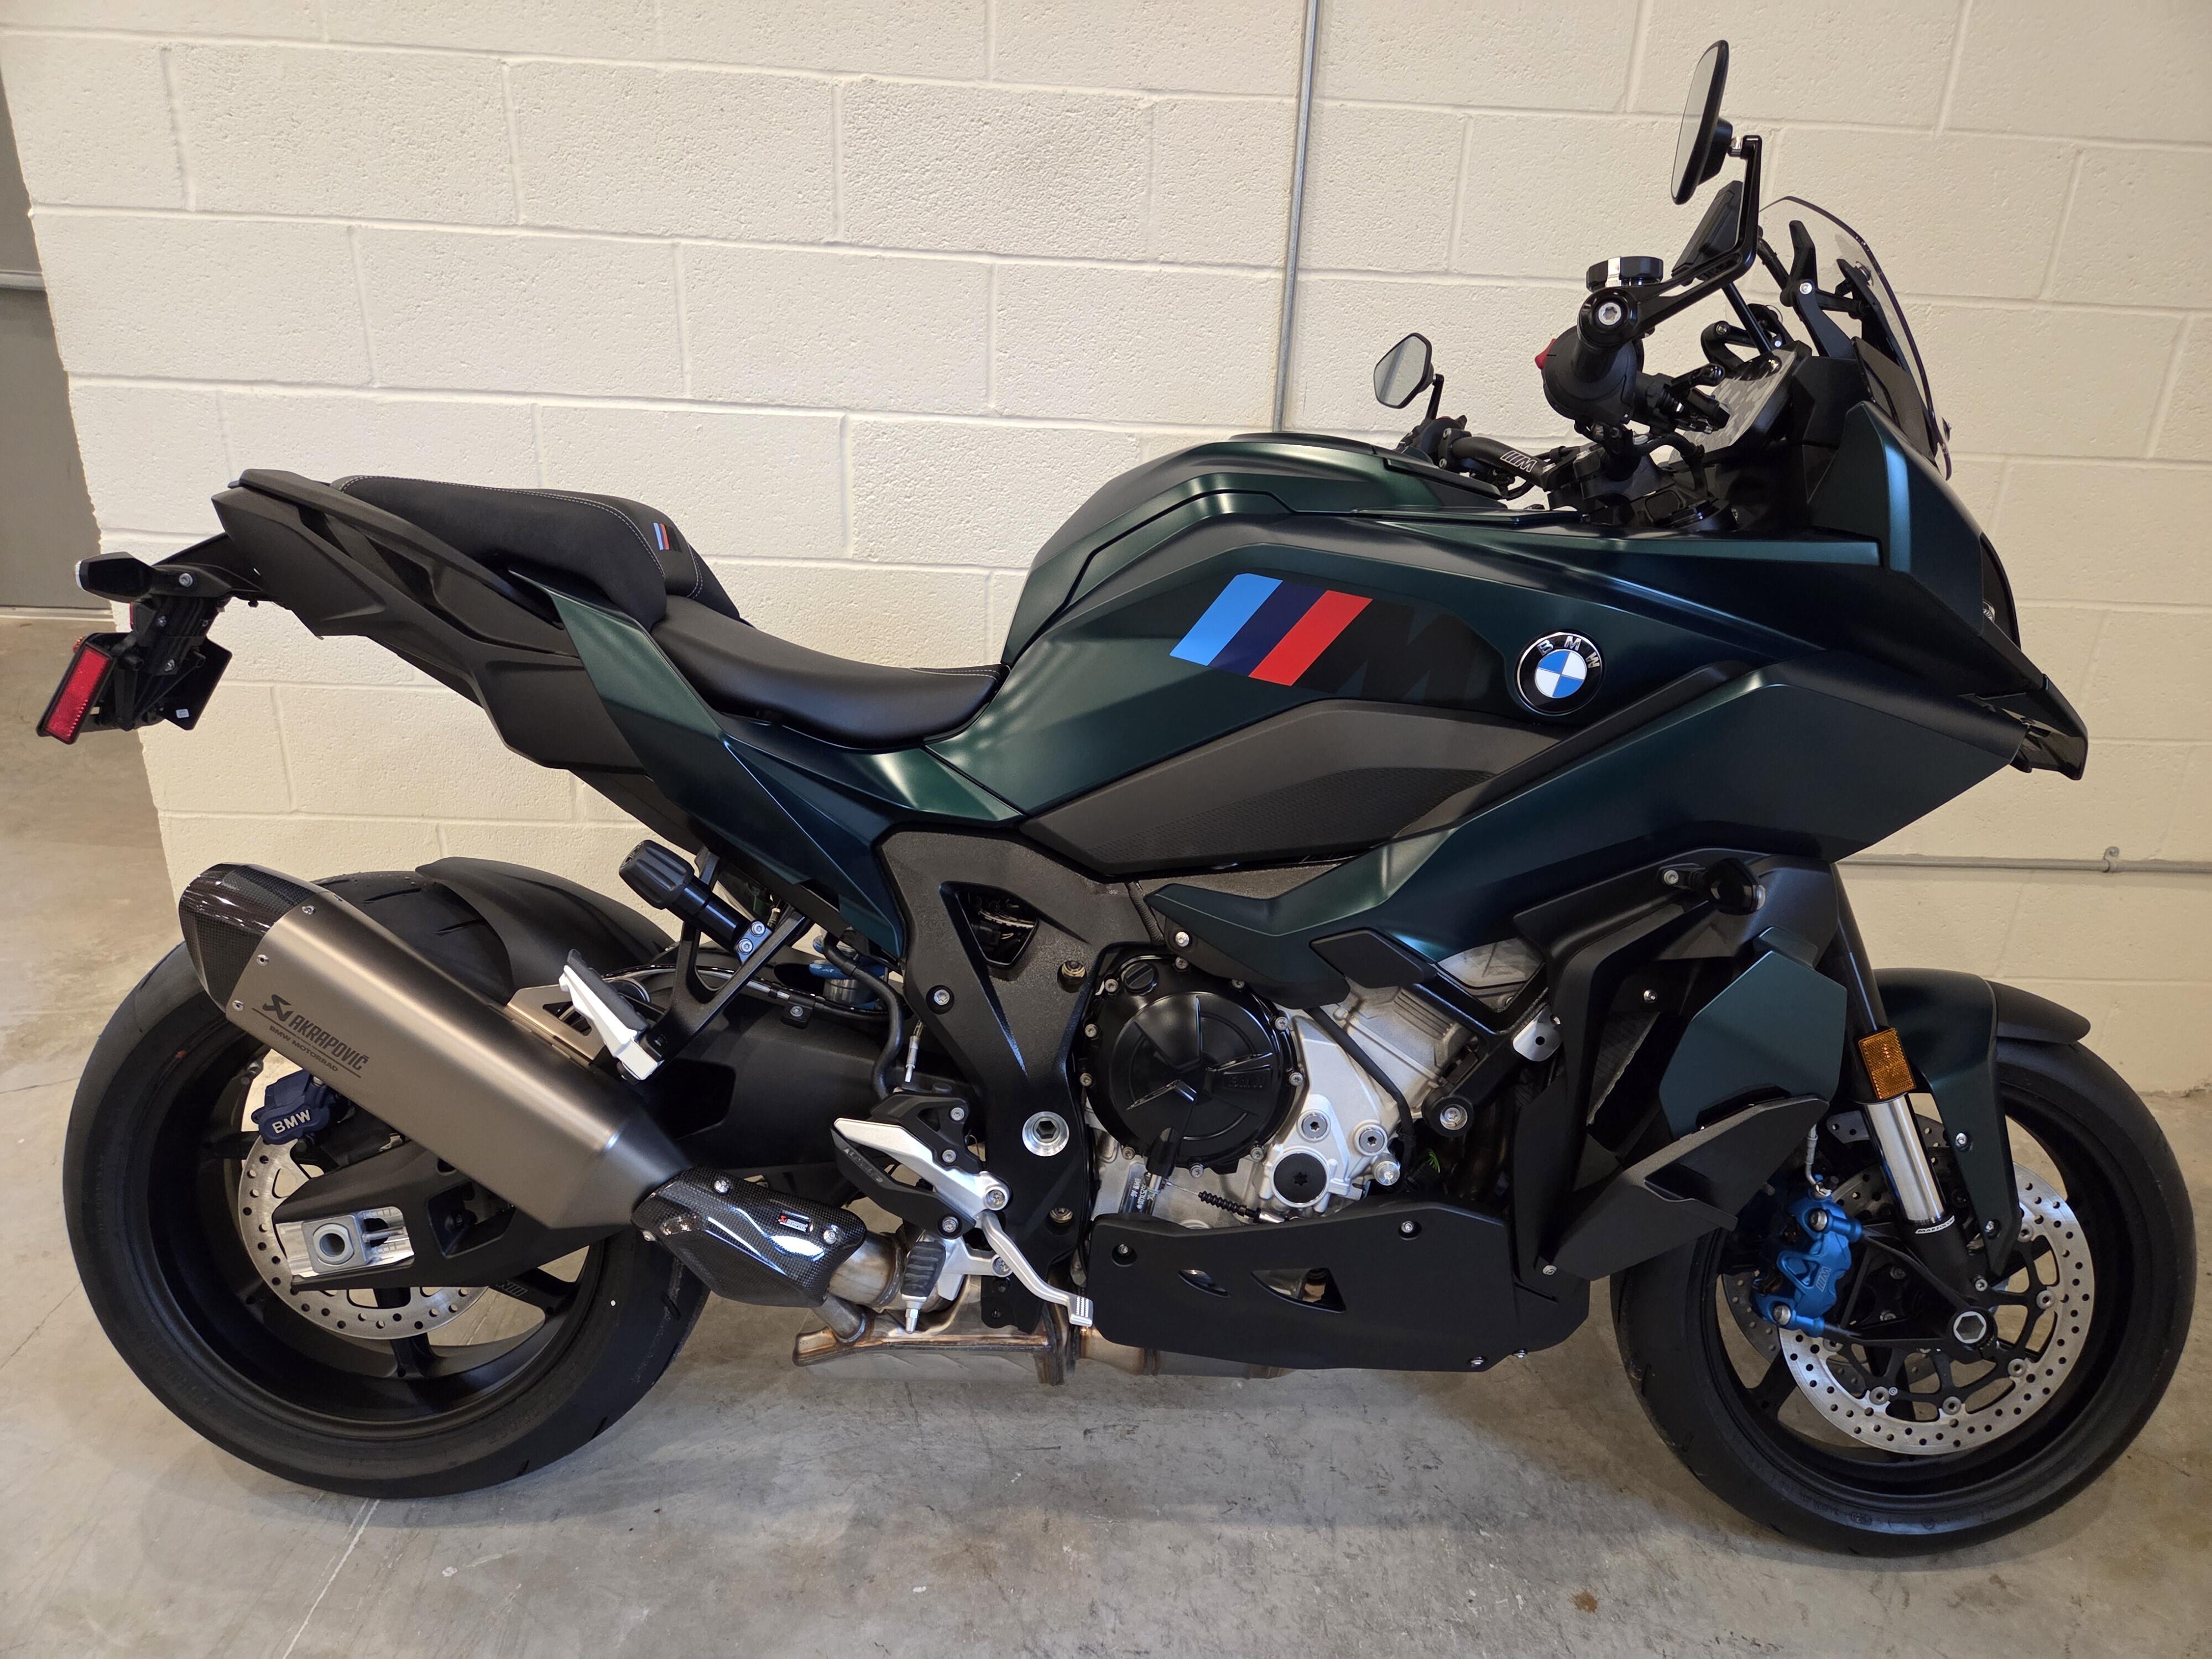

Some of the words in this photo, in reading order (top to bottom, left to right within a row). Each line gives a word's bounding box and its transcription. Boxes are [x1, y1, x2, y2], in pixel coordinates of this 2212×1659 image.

[1536, 635, 1600, 669] BMW
[269, 1025, 291, 1042] BMW
[291, 1040, 339, 1072] MOTORRAD
[272, 1109, 312, 1134] BMW
